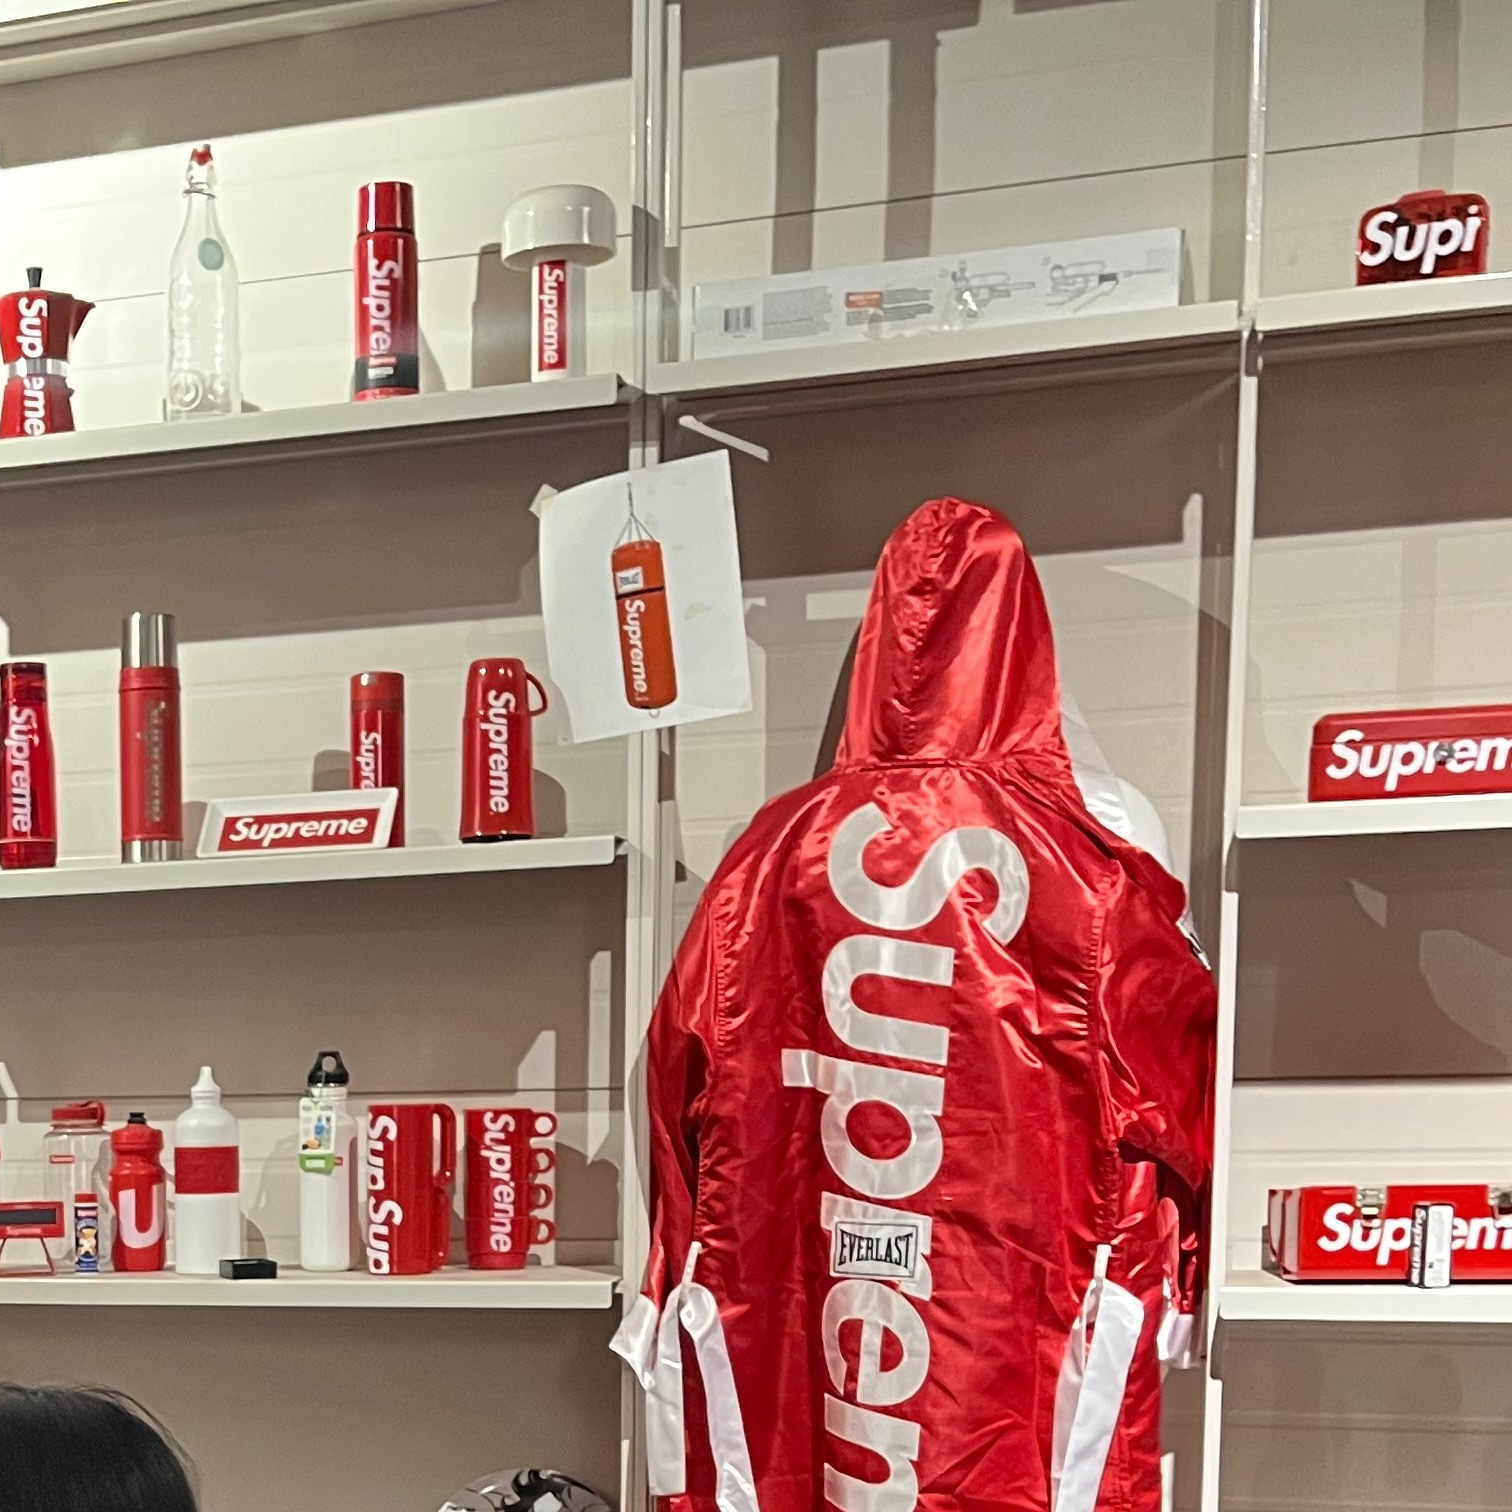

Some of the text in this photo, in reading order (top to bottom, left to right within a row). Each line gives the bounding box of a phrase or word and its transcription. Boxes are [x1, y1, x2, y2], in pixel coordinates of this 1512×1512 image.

[16, 297, 48, 437] Supeme
[539, 264, 565, 364] Supreme
[622, 599, 649, 693] Supreme
[3, 704, 37, 833] Supreme
[480, 689, 516, 815] Supreme
[229, 816, 369, 848] Supreme
[480, 1111, 517, 1253] Supreme
[838, 1228, 914, 1267] EVERLAST
